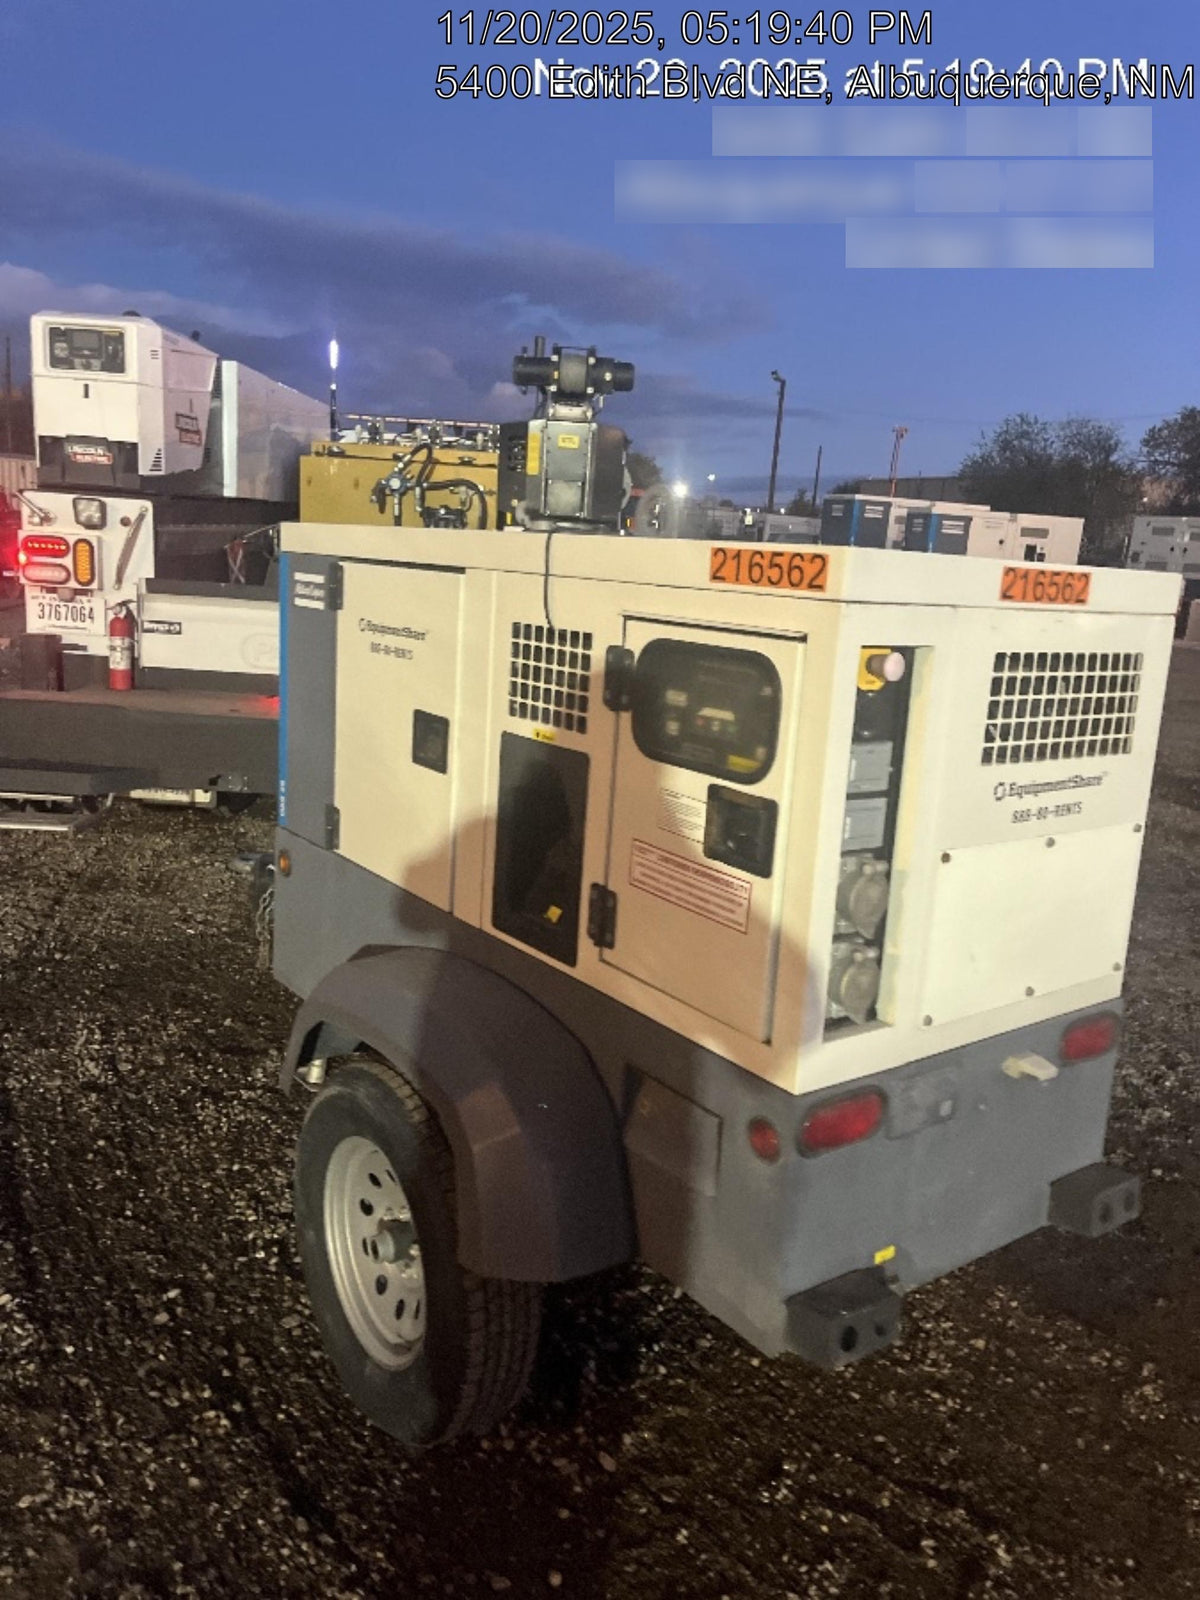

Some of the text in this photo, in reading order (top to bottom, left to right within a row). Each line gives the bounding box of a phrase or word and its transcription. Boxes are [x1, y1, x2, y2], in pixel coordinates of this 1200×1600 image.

[711, 547, 826, 589] 216562
[1001, 567, 1089, 603] 216562
[38, 603, 95, 624] 3767064
